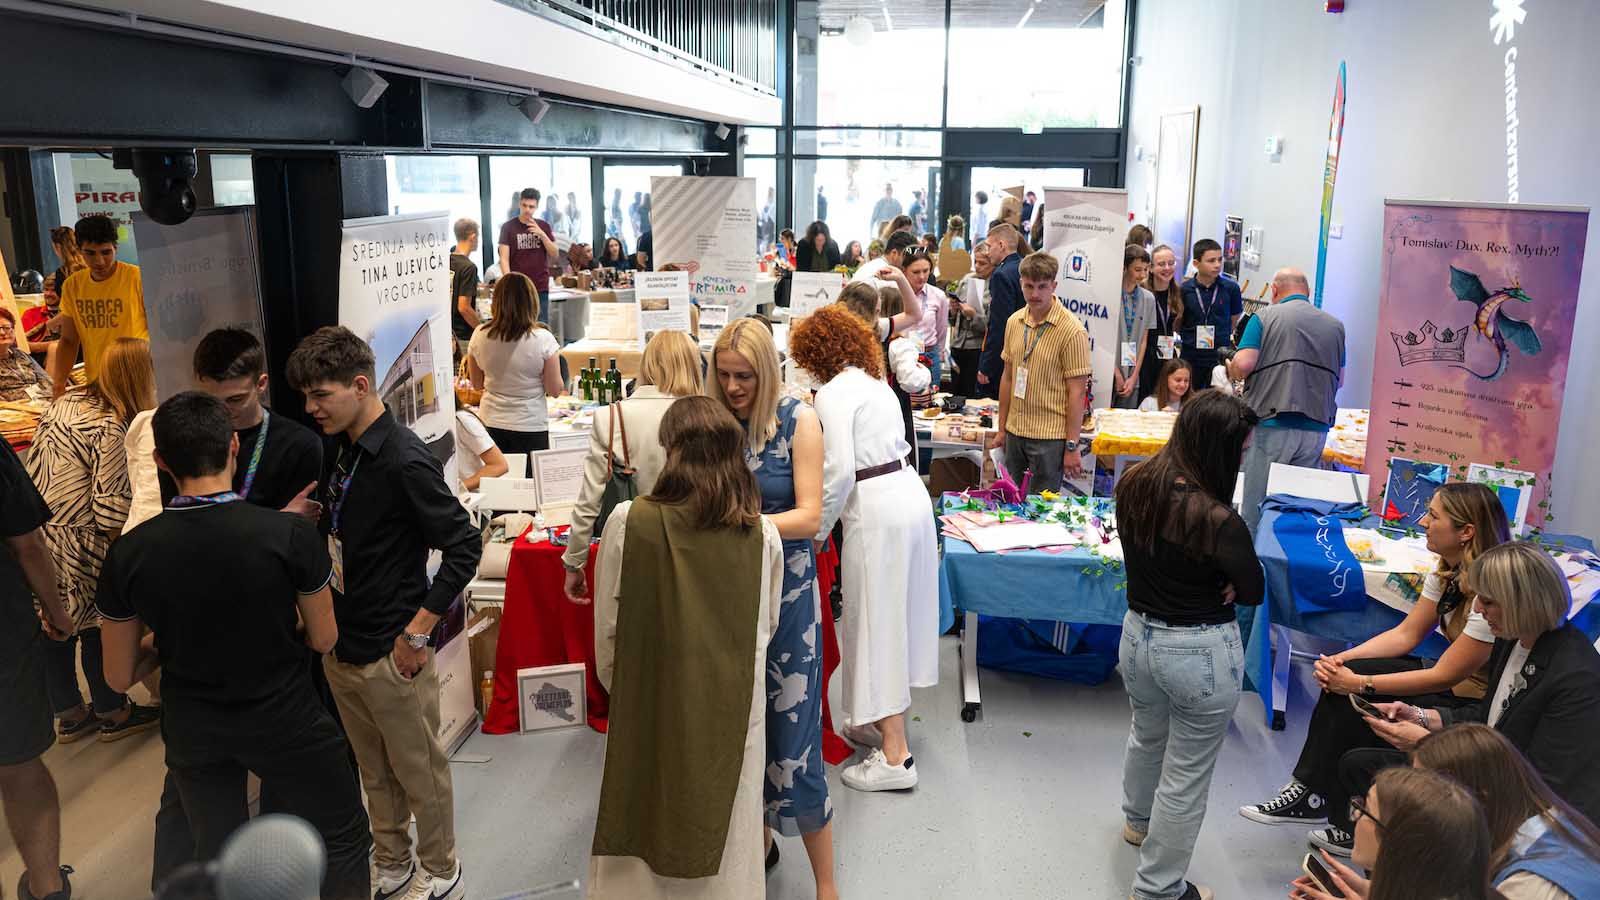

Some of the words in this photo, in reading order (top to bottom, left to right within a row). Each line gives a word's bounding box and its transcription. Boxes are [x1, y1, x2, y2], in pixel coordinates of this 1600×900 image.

[75, 191, 143, 204] PIRA
[352, 239, 405, 262] SREDNJA
[414, 231, 447, 250] ŠKOLA
[1401, 235, 1454, 249] Tomislav:
[361, 264, 388, 285] TINA
[396, 250, 444, 278] UJEVIĆA
[377, 278, 434, 305] VRGORAC
